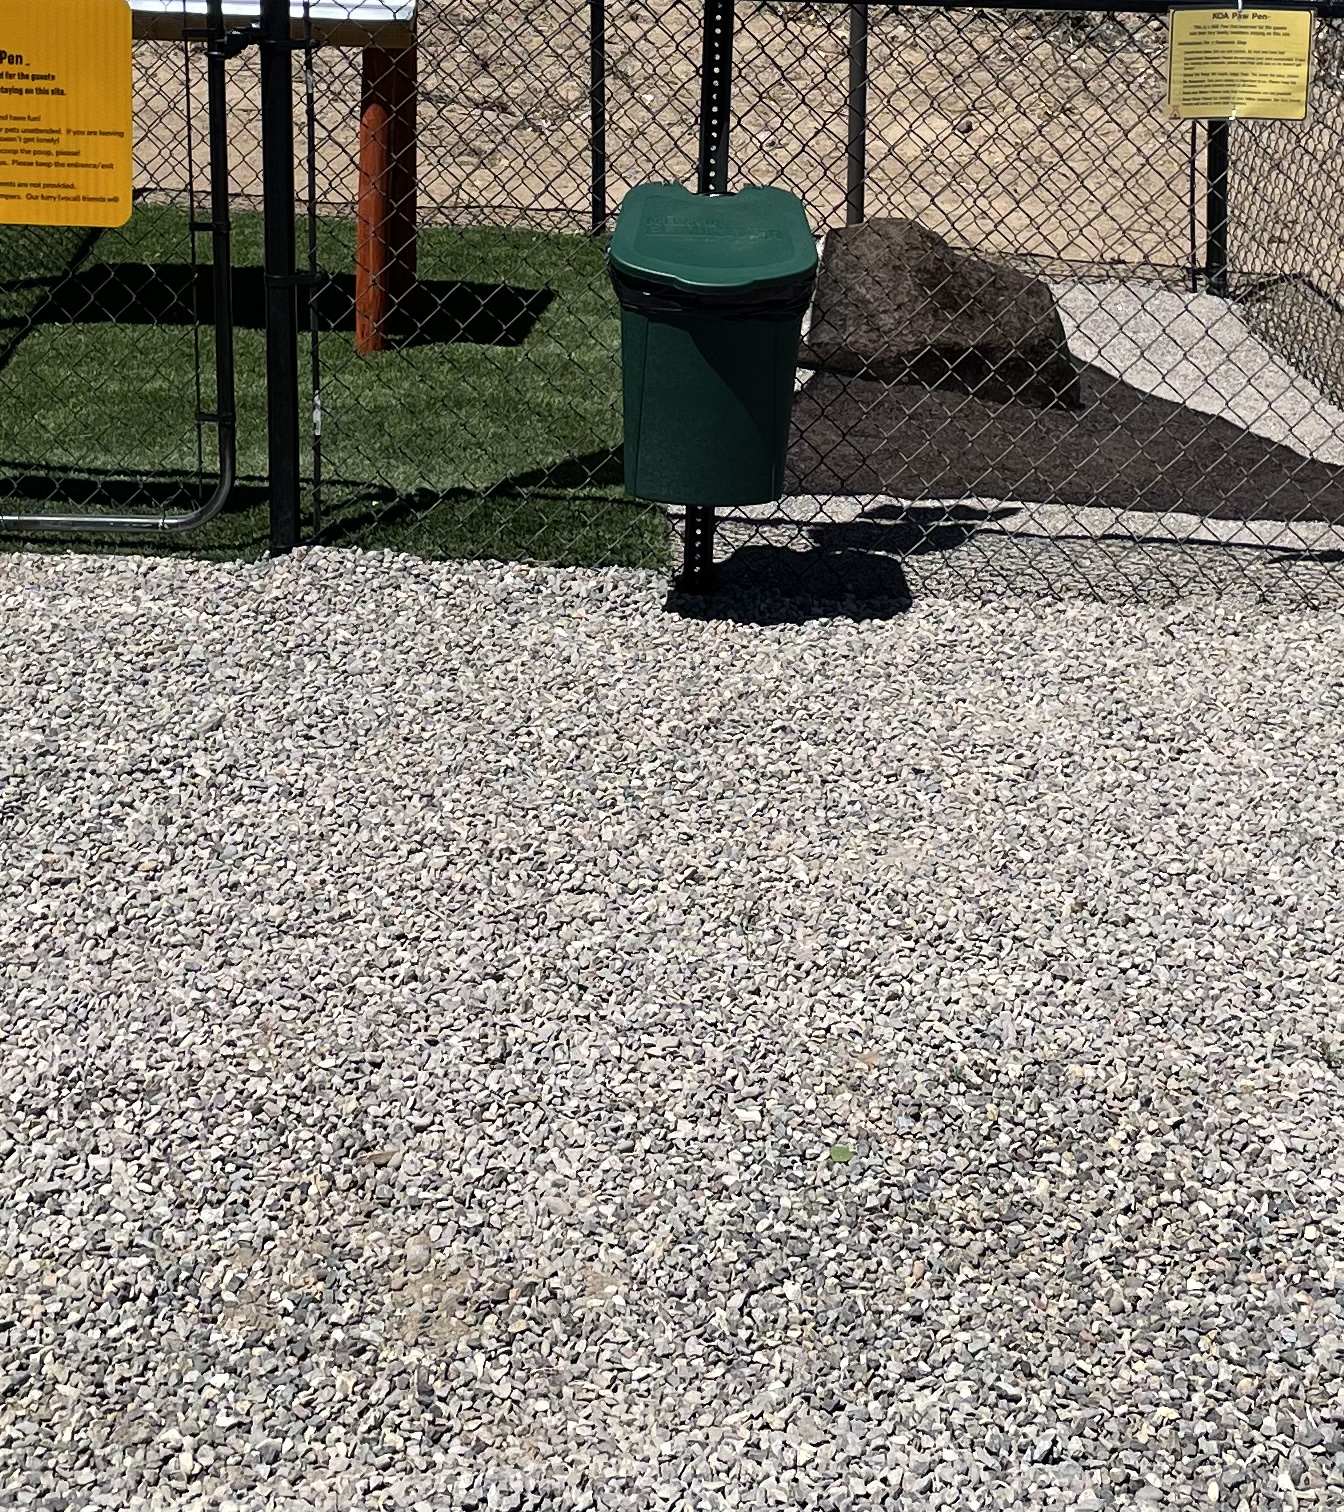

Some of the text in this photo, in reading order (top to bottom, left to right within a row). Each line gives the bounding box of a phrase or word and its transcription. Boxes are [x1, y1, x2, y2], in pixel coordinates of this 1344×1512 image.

[0, 49, 23, 65] Pen
[5, 71, 16, 80] for
[17, 71, 29, 80] the
[31, 73, 56, 82] guests
[35, 87, 49, 95] this
[51, 87, 67, 96] site.
